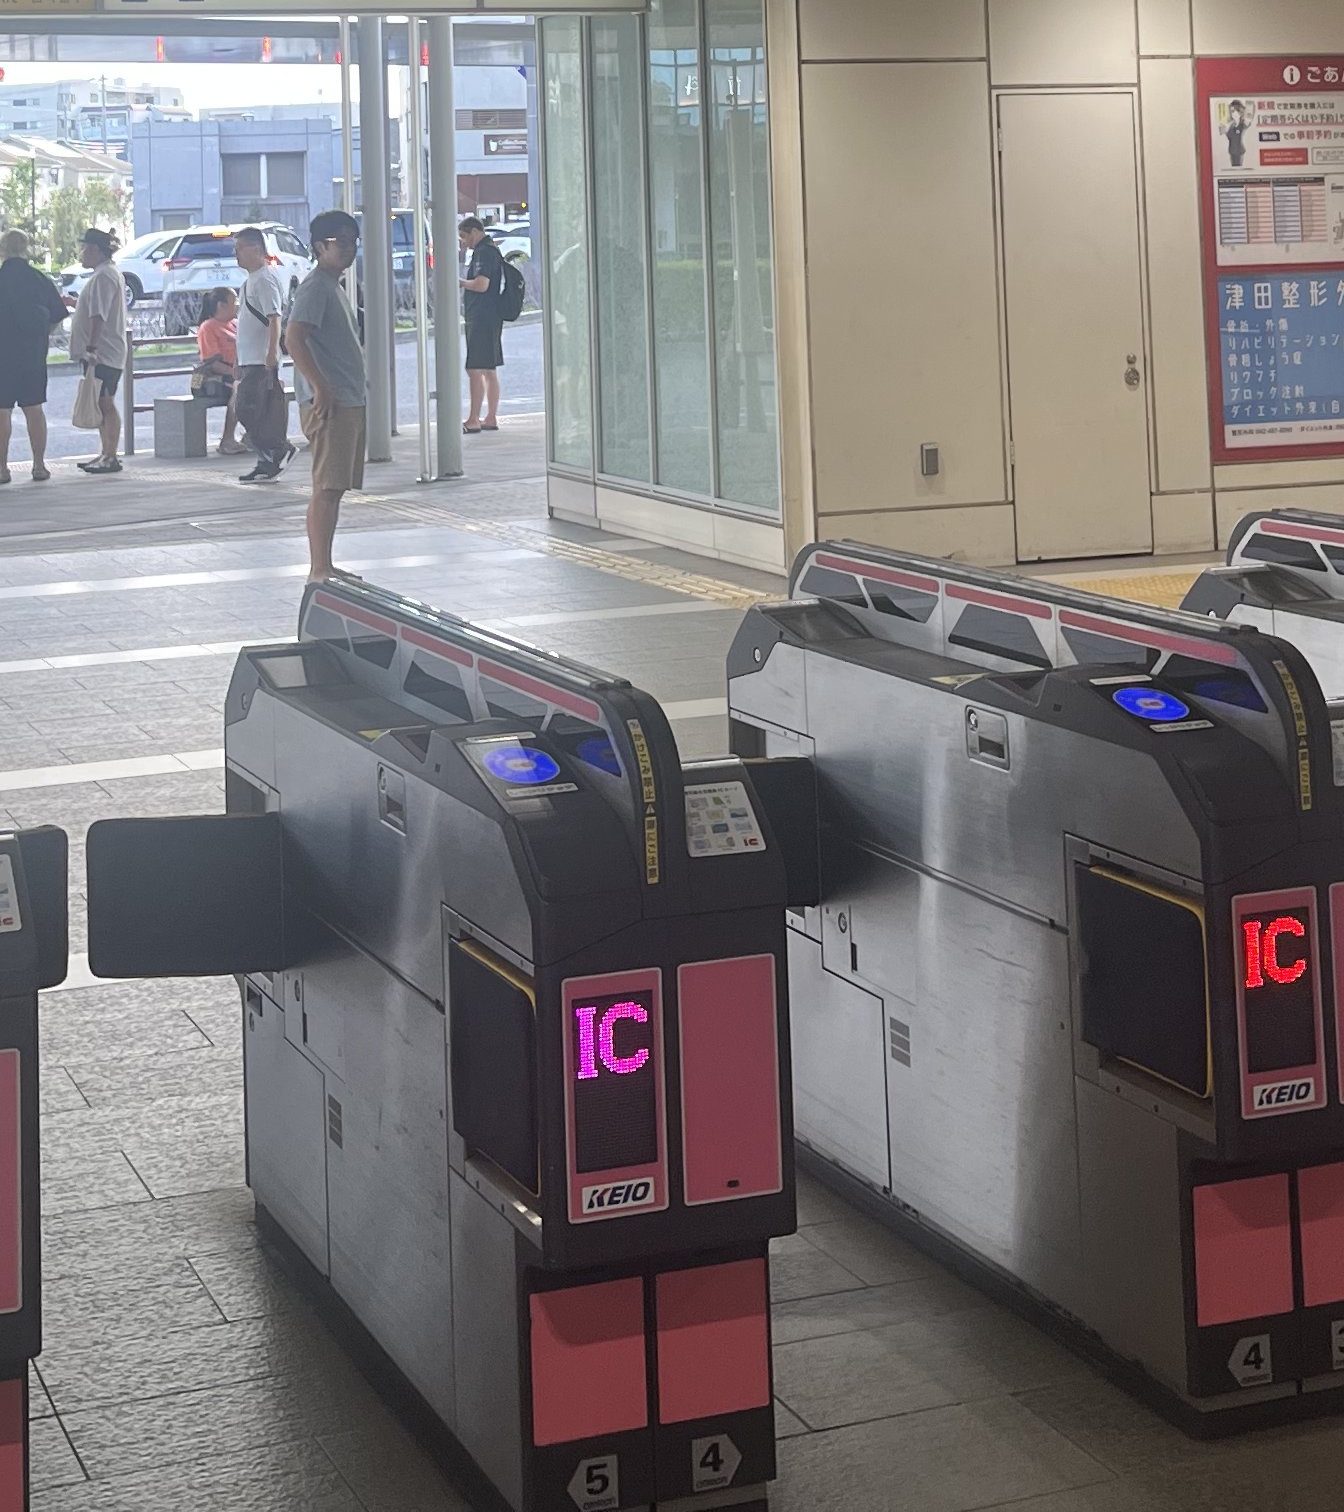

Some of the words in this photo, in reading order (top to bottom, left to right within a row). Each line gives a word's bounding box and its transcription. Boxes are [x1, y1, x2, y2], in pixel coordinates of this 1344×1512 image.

[1228, 334, 1340, 350] リハビリテーション
[1230, 370, 1277, 384] リウマチ
[1243, 916, 1306, 988] IC
[575, 1001, 649, 1079] IC
[1257, 1082, 1311, 1107] KEIO
[587, 1182, 650, 1209] KEIO
[1243, 1342, 1264, 1370] 4
[699, 1442, 724, 1472] 4
[585, 1463, 609, 1495] 5
